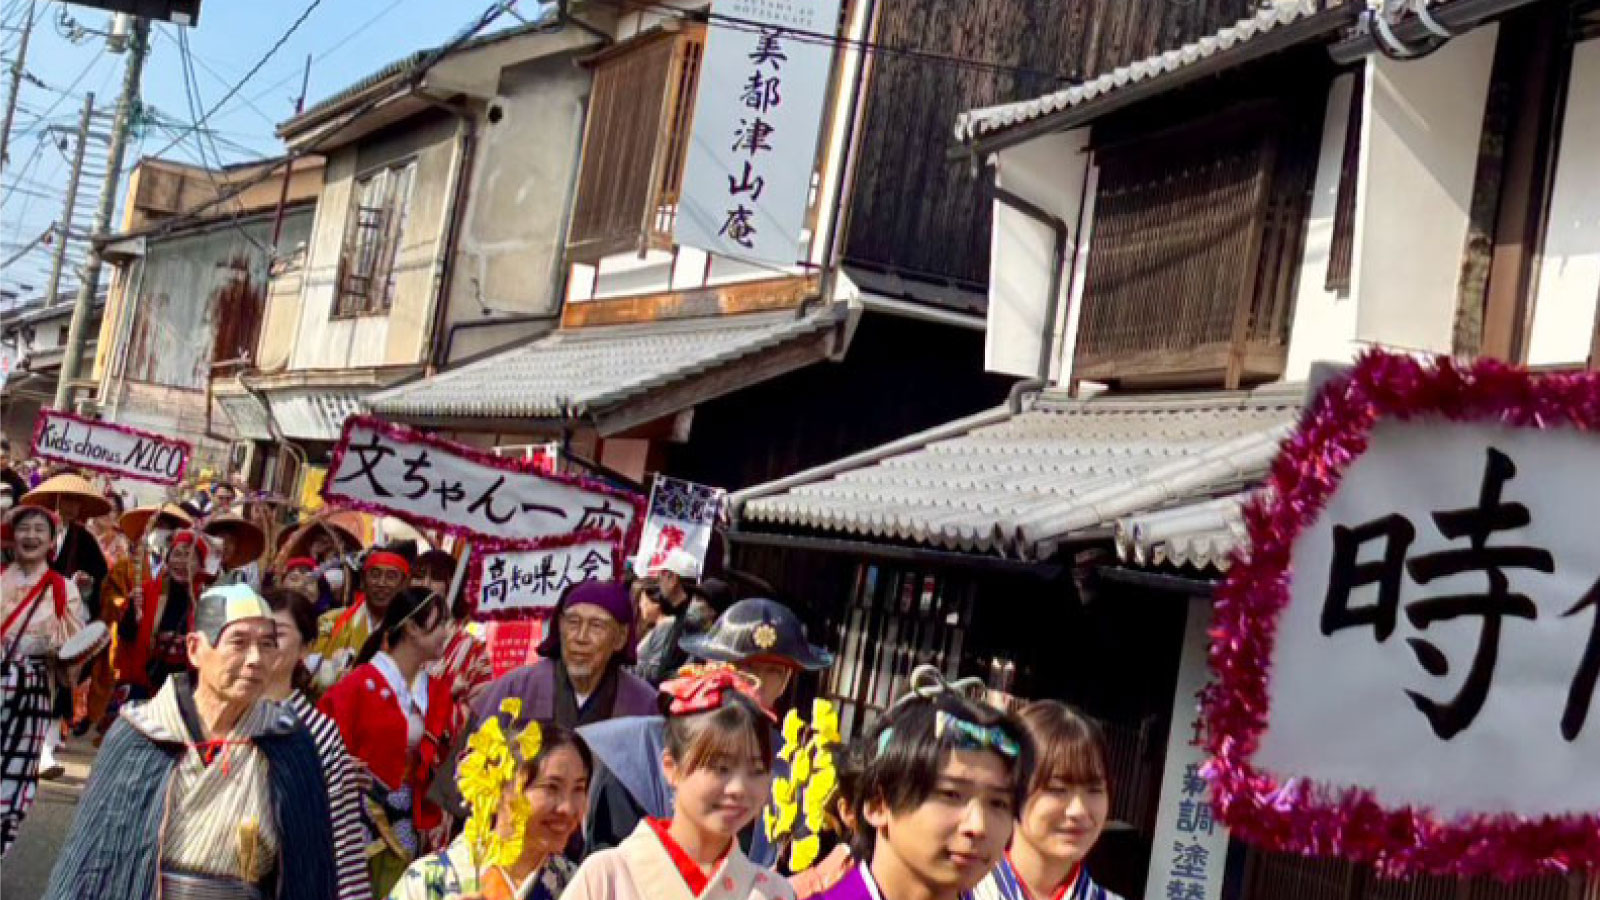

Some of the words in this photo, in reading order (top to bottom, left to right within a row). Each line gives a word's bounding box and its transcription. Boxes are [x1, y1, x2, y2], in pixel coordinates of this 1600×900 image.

[718, 29, 788, 249] 美都津山庵
[38, 417, 74, 452] Kids
[124, 438, 184, 478] NICO
